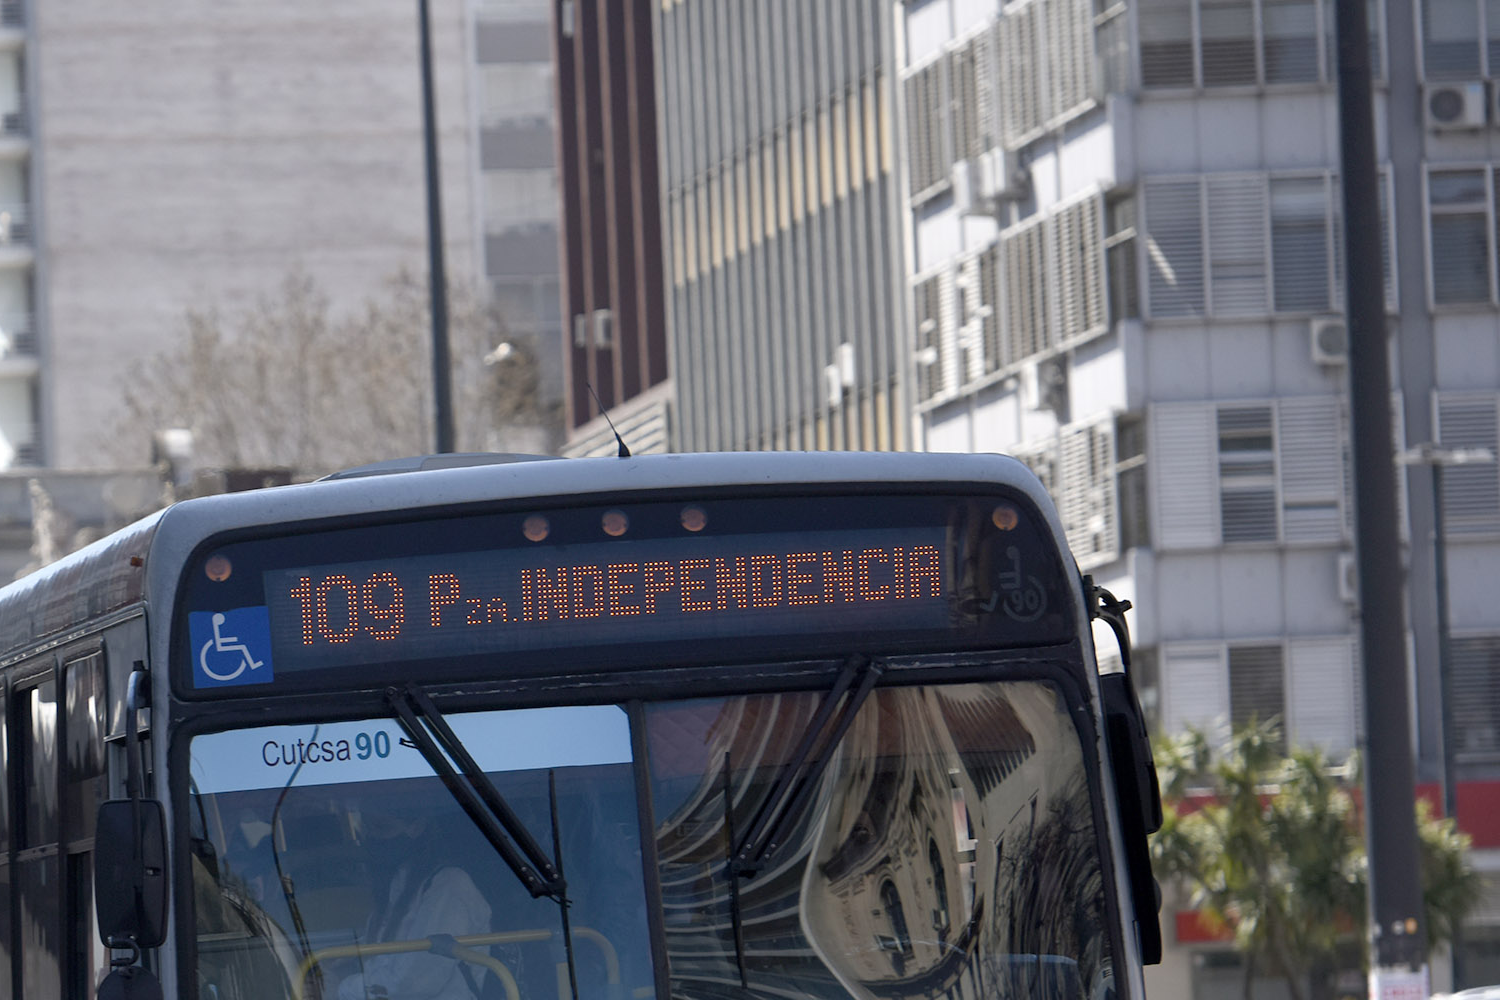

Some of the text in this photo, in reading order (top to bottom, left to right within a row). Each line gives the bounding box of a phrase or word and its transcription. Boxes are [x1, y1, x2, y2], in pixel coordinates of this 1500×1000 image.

[290, 571, 405, 645] 109
[262, 730, 391, 767] Cutcsa 90
